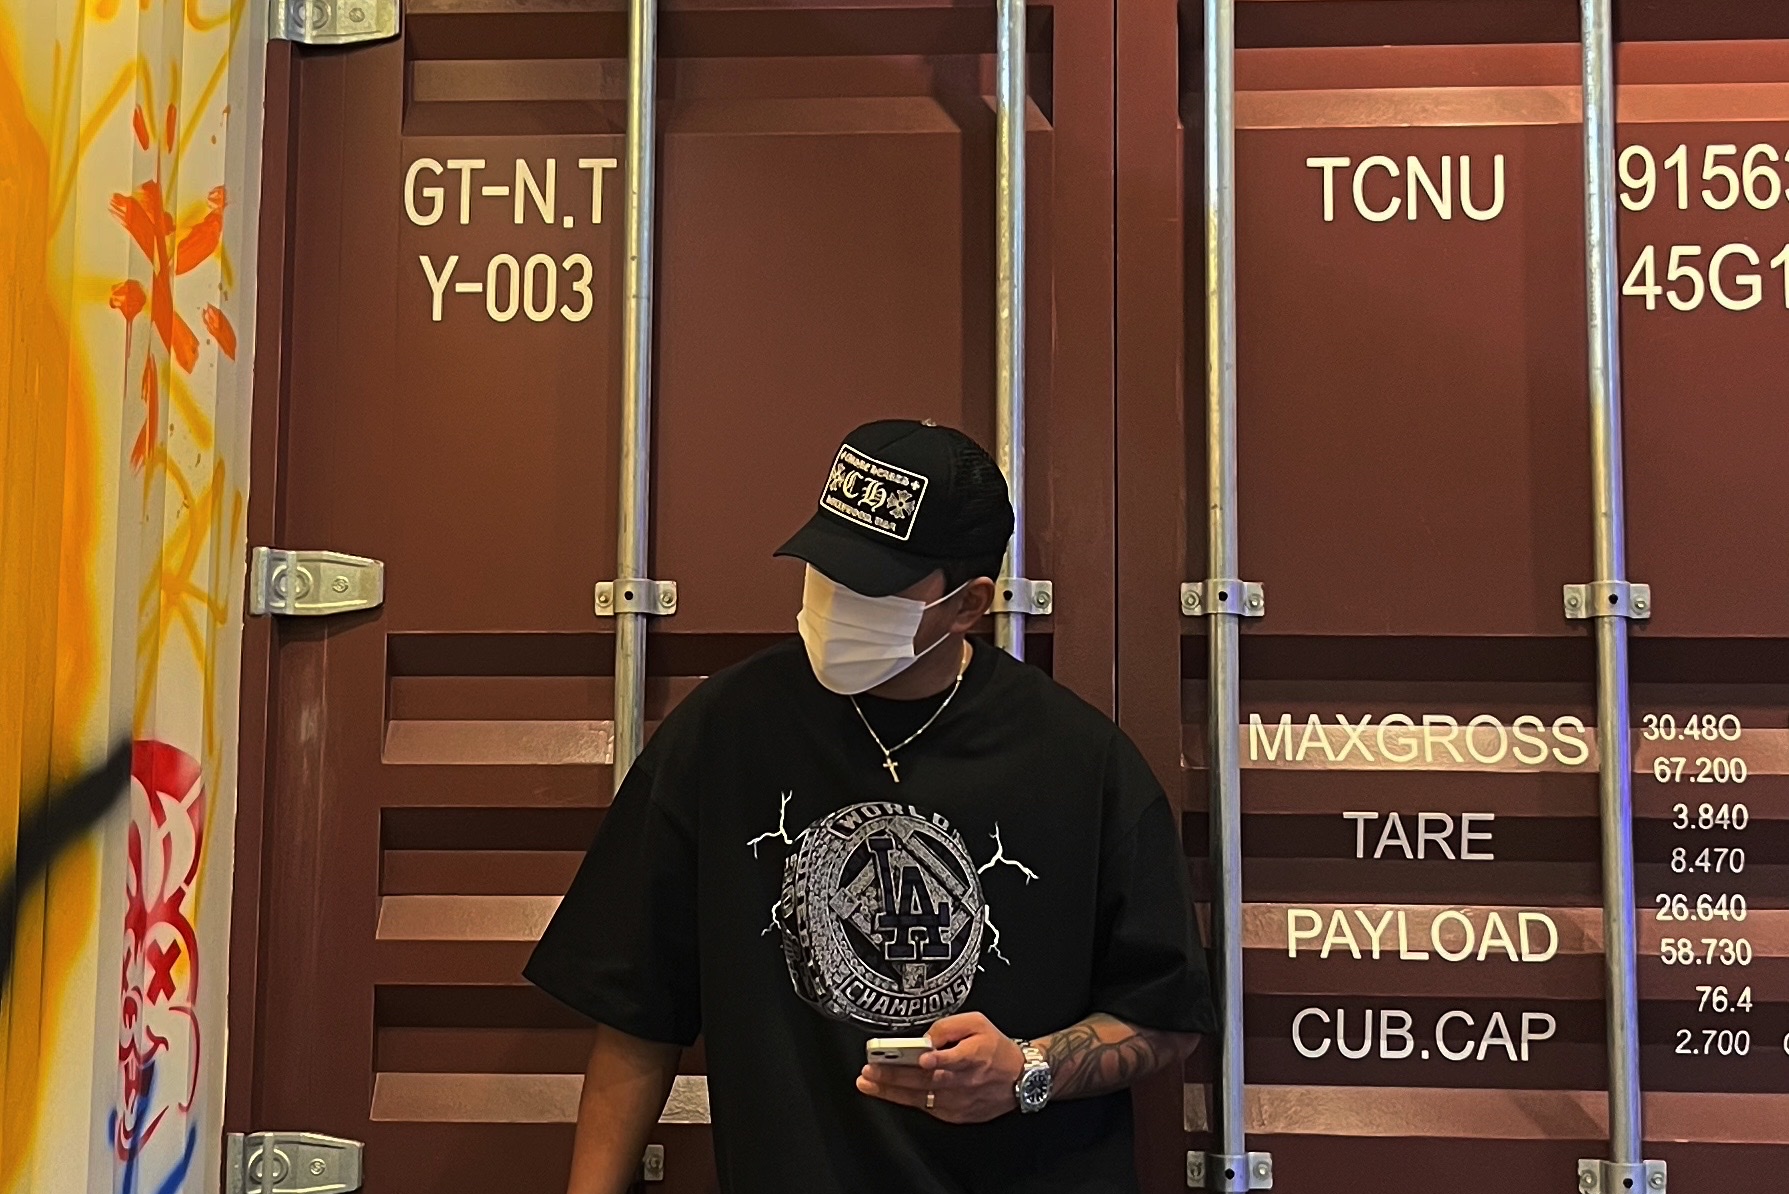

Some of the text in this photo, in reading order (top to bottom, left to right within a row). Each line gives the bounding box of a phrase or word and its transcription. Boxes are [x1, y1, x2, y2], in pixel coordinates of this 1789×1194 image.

[404, 157, 618, 229] GT-N.T
[1306, 153, 1505, 222] TCNU
[418, 253, 594, 322] Y-003
[1248, 713, 1589, 765] MAXGROSS
[1653, 756, 1748, 784] 67.200
[839, 802, 951, 833] WORLD
[1342, 811, 1495, 860] TARE
[1672, 802, 1749, 830] 3.840
[1670, 847, 1745, 874] 8.470
[867, 835, 951, 960] LA
[1655, 893, 1748, 922] 26.640
[1287, 908, 1559, 962] PAYLOAD
[1660, 937, 1753, 966] 58.730
[845, 977, 967, 1016] CHAMPIONS
[1695, 985, 1753, 1013] 76.4
[1292, 1007, 1556, 1063] CUB.CAP
[1674, 1029, 1751, 1057] 2.700
